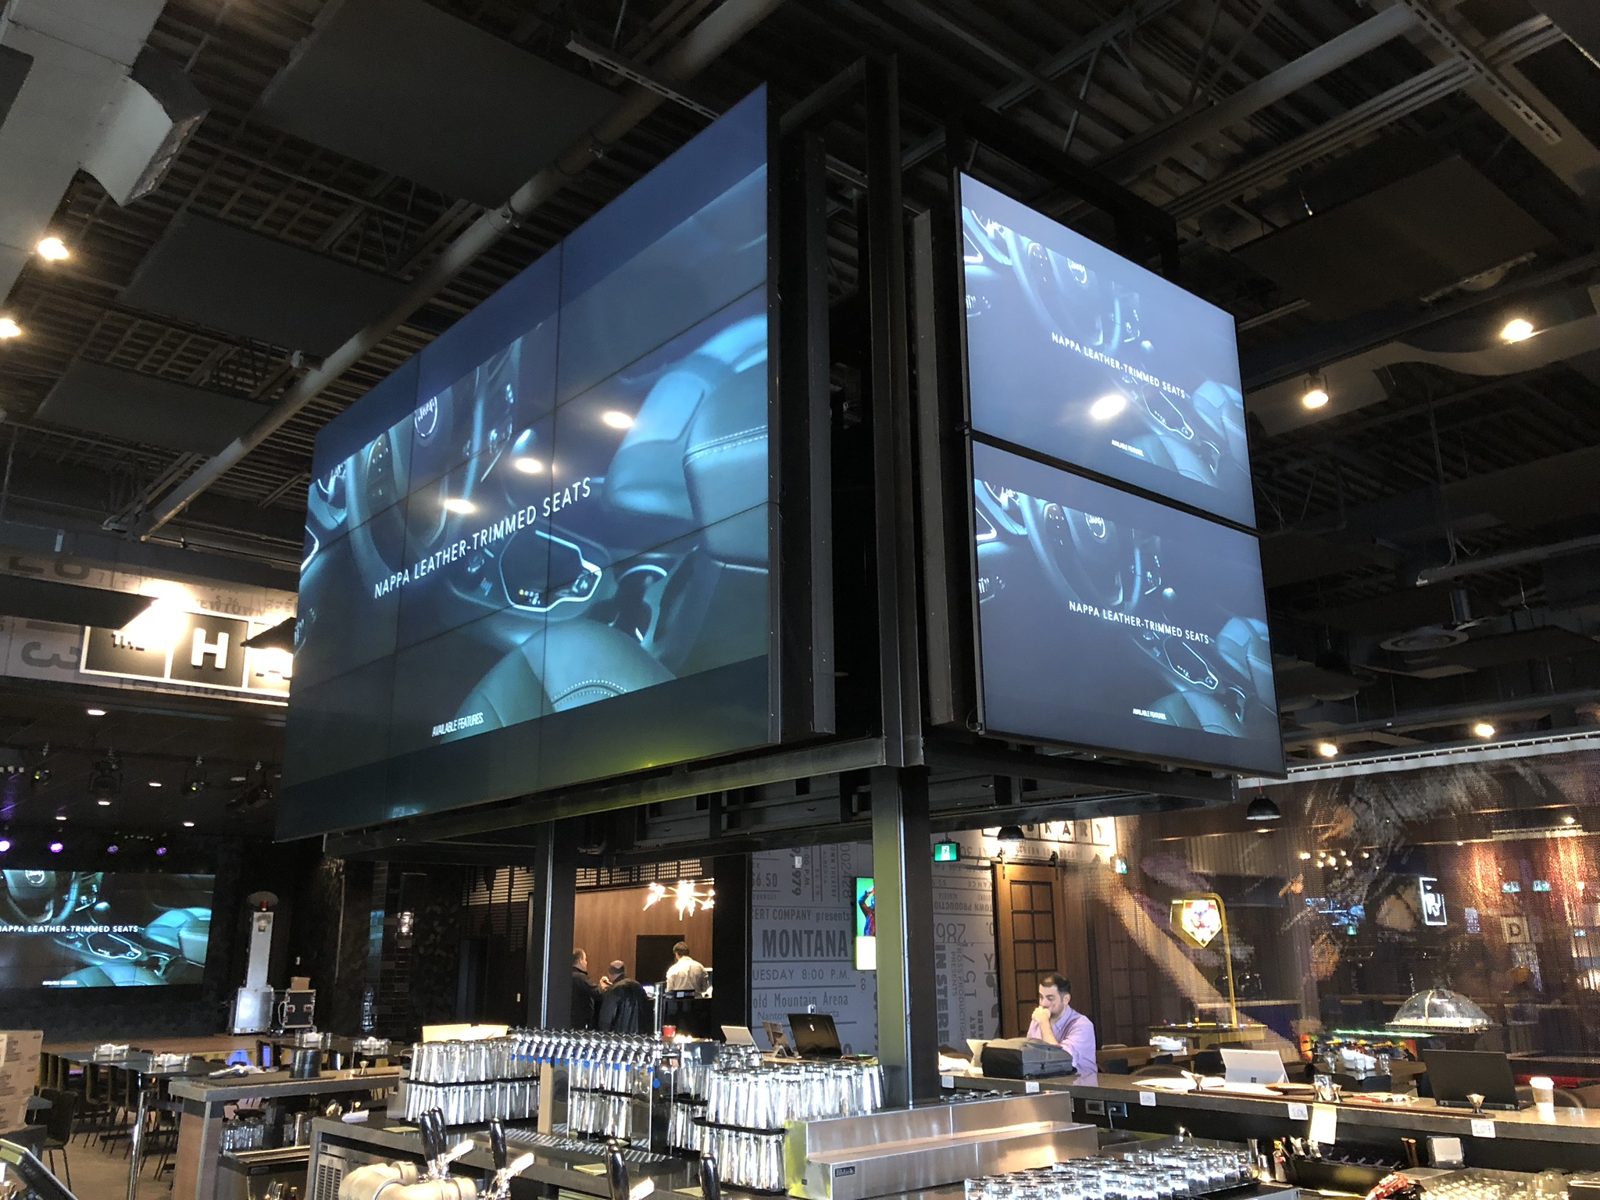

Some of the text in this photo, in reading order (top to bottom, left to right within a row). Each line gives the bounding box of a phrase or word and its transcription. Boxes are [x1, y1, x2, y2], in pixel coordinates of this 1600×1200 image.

[1051, 332, 1186, 399] NAPPA LEATHER-TRIMMED SEATS
[374, 477, 591, 599] NAPPA LEATHER-TRIMMED SEATS
[1068, 601, 1210, 645] NAPPA LEATHER-TRIMMED SEATS
[772, 908, 812, 920] COMPANY
[27, 925, 110, 933] LEATHER-TRIMMED
[112, 925, 139, 933] SEATS
[762, 929, 849, 958] MONTANA
[801, 968, 824, 980] 8:00
[774, 992, 817, 1008] Mountain
[823, 991, 849, 1006] Arena
